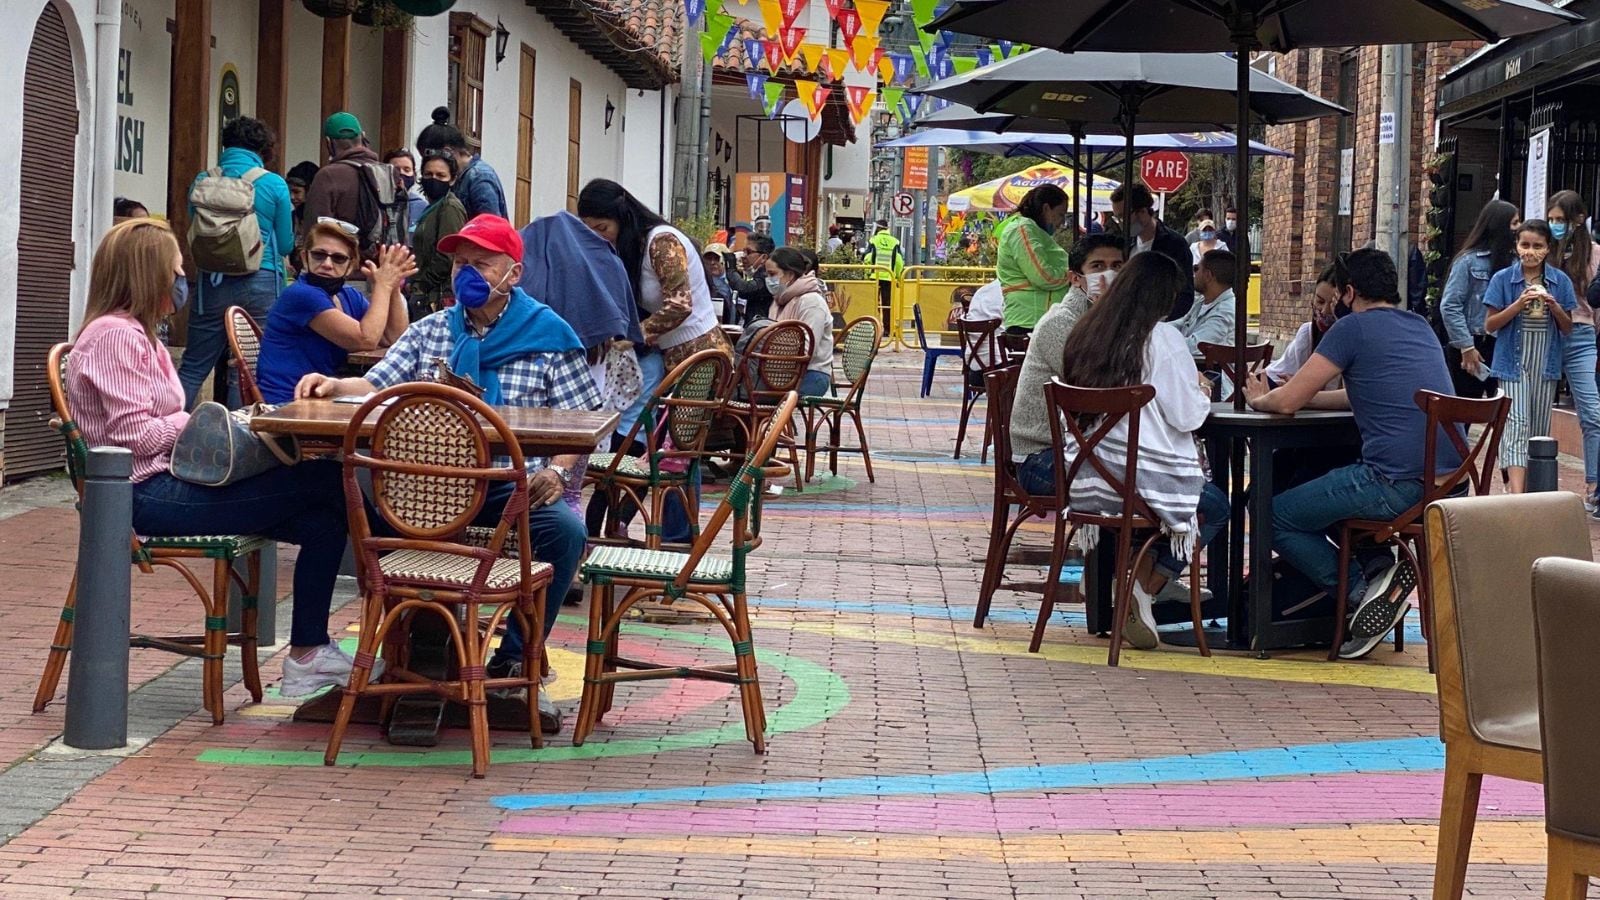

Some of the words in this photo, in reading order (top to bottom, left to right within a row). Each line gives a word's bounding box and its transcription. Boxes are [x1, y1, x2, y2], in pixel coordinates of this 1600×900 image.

[1041, 92, 1088, 103] BBC
[115, 115, 144, 175] ISH
[1145, 159, 1184, 178] PARE
